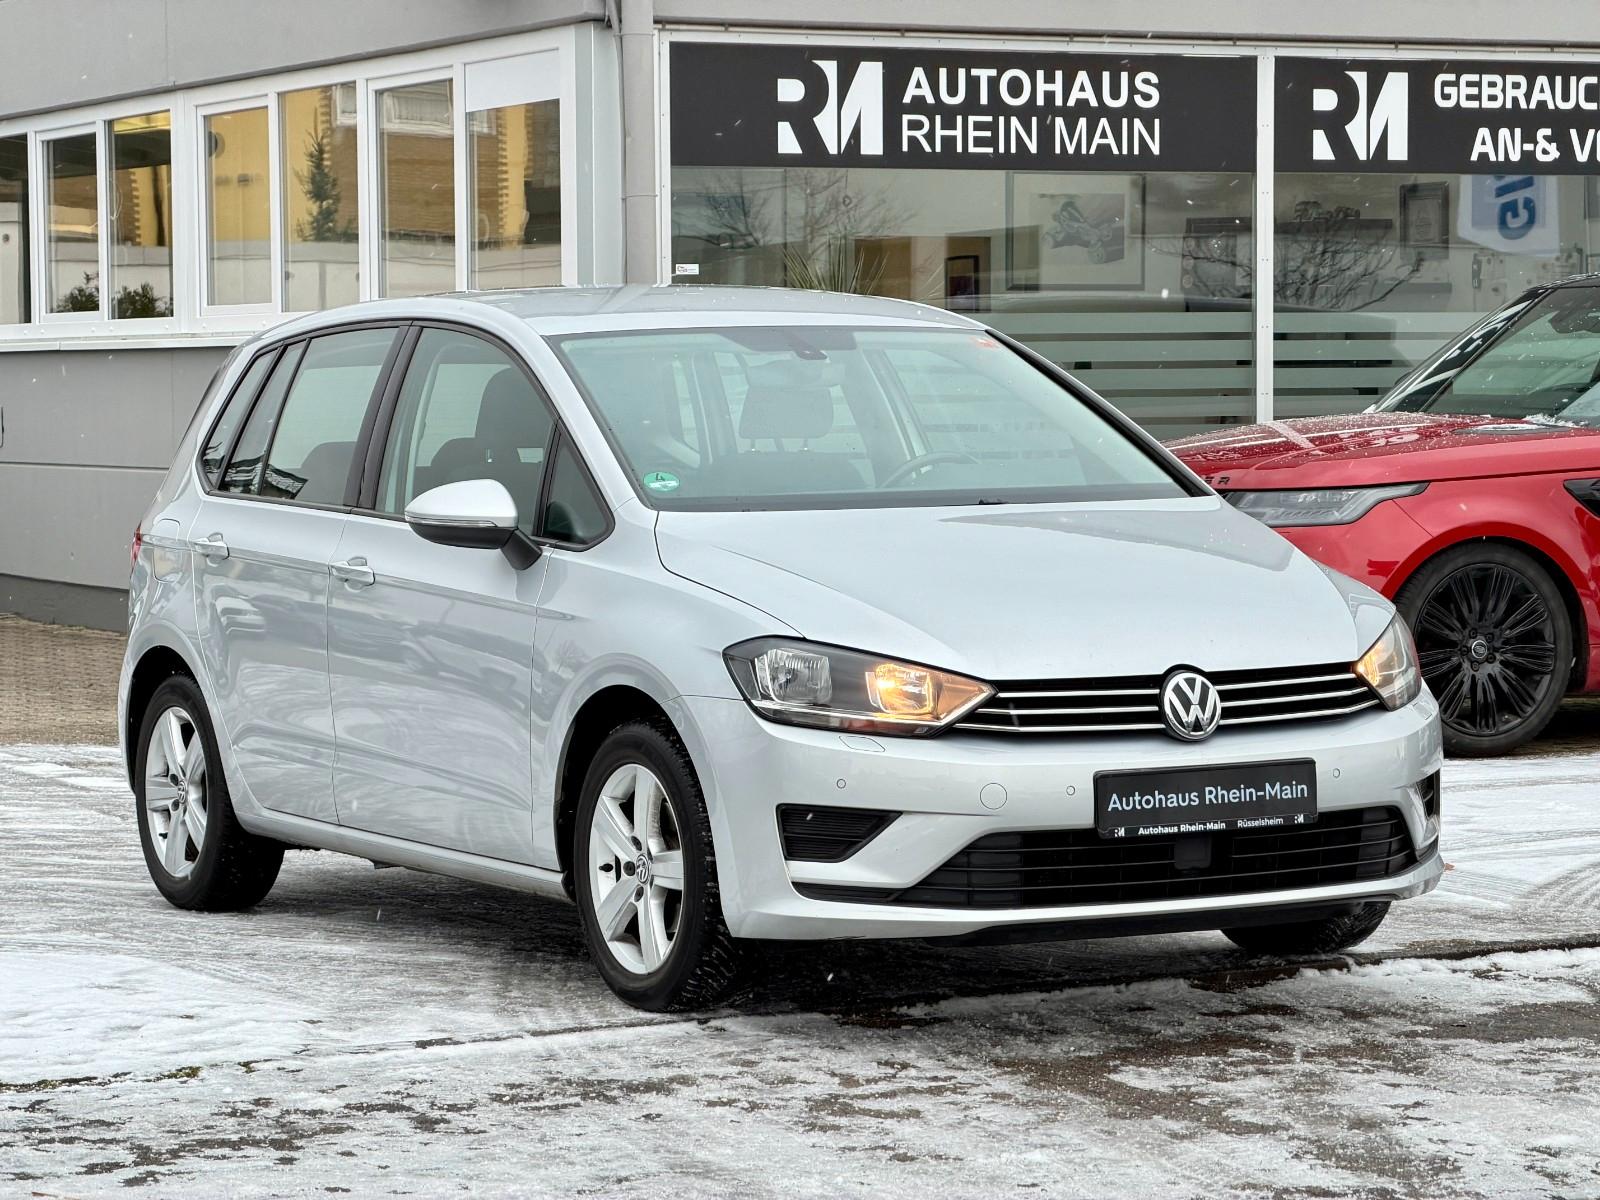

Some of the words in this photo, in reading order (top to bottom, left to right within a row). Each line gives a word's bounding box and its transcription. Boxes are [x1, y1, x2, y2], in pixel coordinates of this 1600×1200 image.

[902, 66, 1160, 109] AUTOHAUS
[901, 113, 1038, 154] RHEIN
[1053, 115, 1161, 156] MAIN
[1470, 126, 1561, 162] AN-&
[1569, 128, 1600, 162] V
[1164, 671, 1221, 740] VW
[1107, 790, 1200, 812] Autohaus
[1204, 781, 1308, 805] Rhein-Main
[1137, 823, 1179, 836] Autohaus
[1180, 820, 1226, 834] Rhein-Main
[1237, 816, 1284, 829] Rüsselsheim
